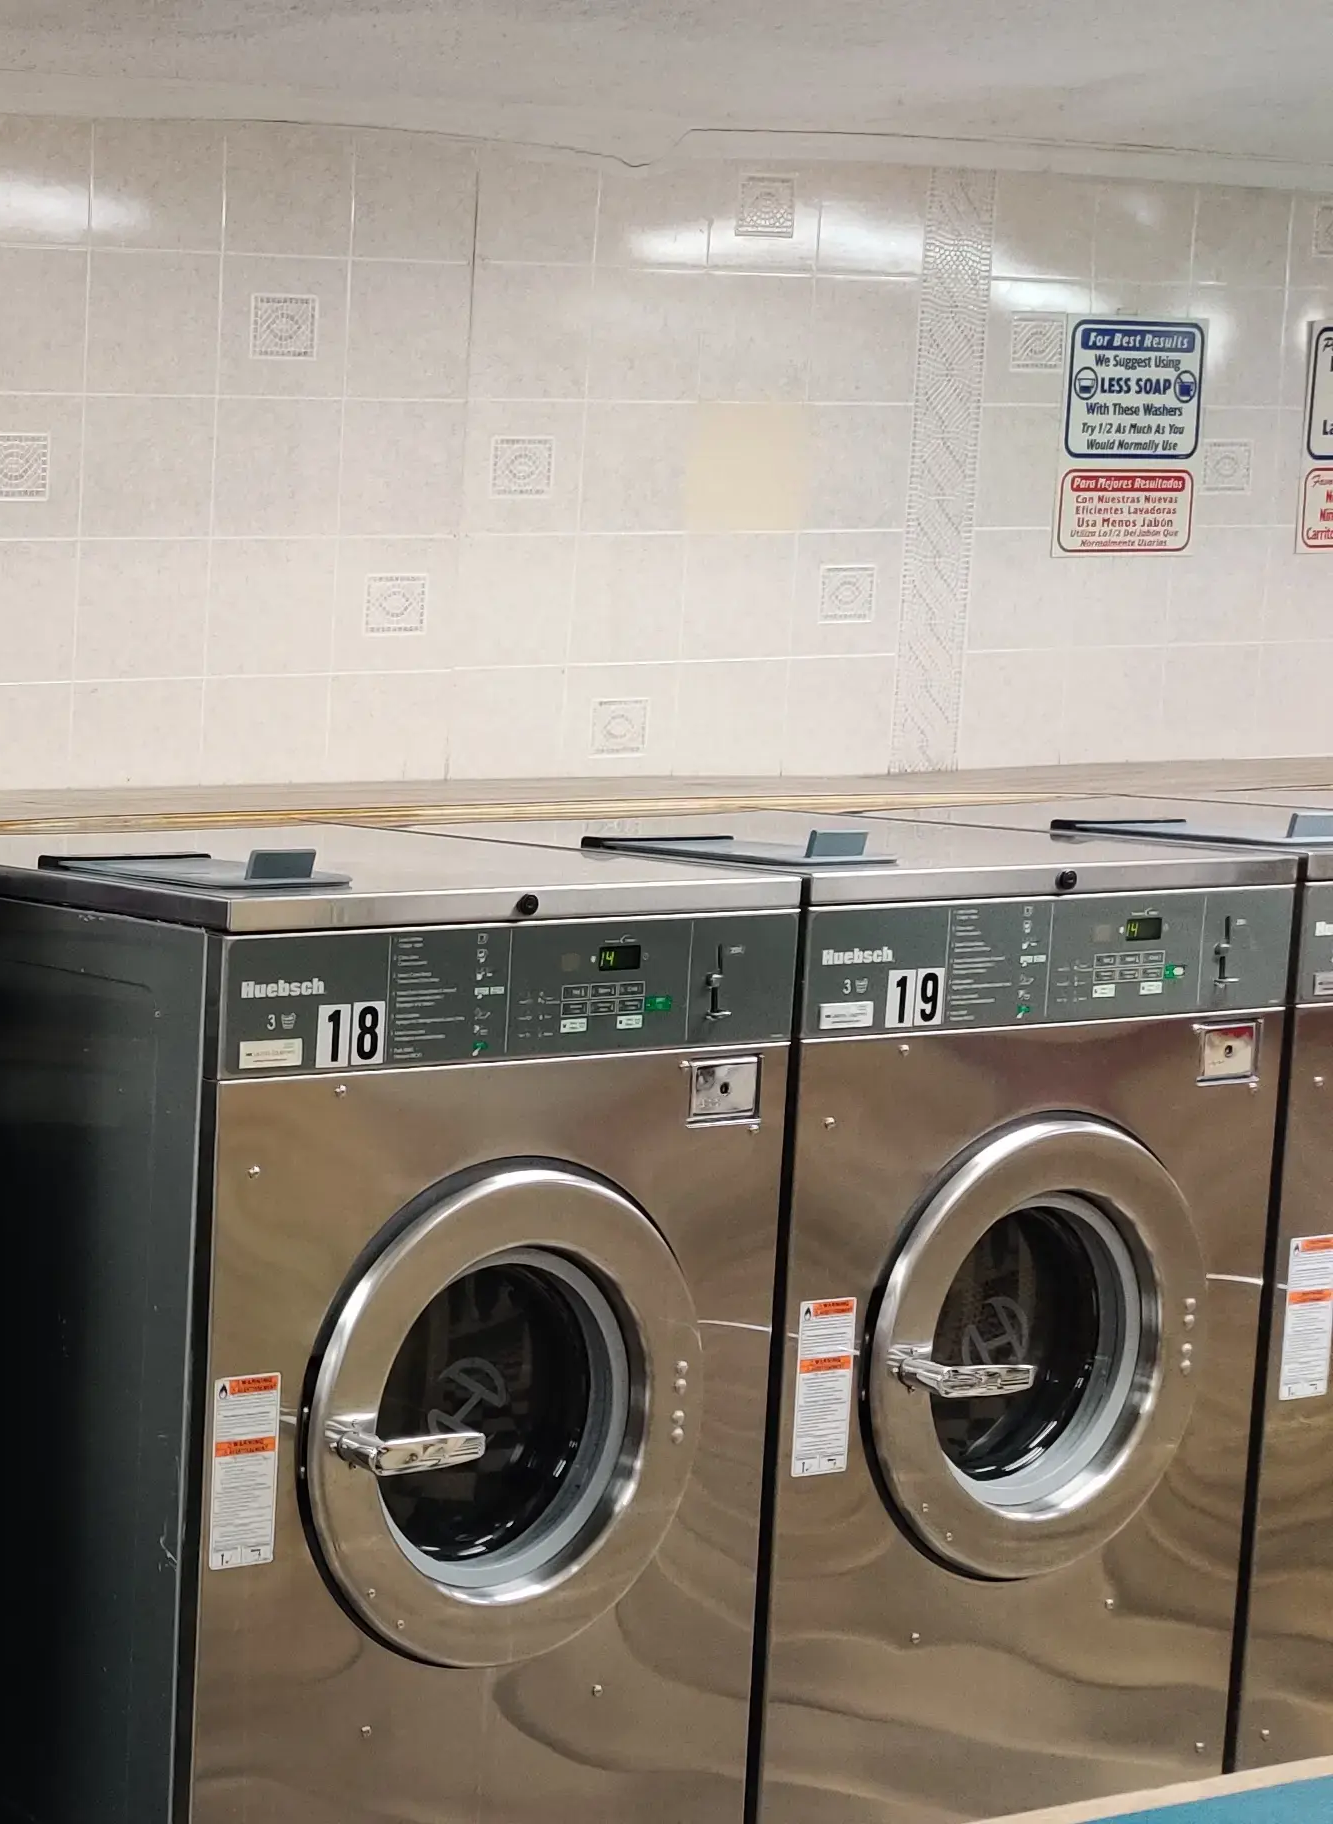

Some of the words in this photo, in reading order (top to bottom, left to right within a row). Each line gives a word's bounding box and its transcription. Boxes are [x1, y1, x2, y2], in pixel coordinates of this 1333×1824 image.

[1088, 332, 1111, 346] For
[1113, 333, 1141, 347] Best
[1144, 334, 1189, 348] Results
[1095, 354, 1111, 367] We
[1113, 355, 1151, 370] Suggest
[1154, 356, 1181, 371] Using
[1100, 377, 1131, 394] LESS
[1135, 378, 1172, 395] SOAP
[1086, 402, 1109, 416] With
[1112, 403, 1140, 416] These
[1143, 403, 1183, 417] Washers
[1081, 422, 1096, 436] Try
[1098, 422, 1112, 435] 1/2
[1115, 423, 1126, 434] As
[1128, 423, 1152, 435] Much
[1154, 424, 1165, 435] As
[1168, 424, 1185, 435] You
[1086, 439, 1115, 450] Would
[1117, 439, 1160, 453] Normally
[1162, 440, 1178, 451] Use
[1073, 478, 1095, 488] Para
[1097, 477, 1132, 490] Mejores
[1134, 478, 1183, 489] Resultados
[1076, 495, 1094, 504] Con
[1097, 495, 1140, 504] Nuestras
[1144, 495, 1178, 504] Nuevas
[1075, 506, 1124, 515] Eficientes
[1128, 506, 1177, 515] Lavadoras
[1077, 517, 1097, 527] Usa
[1101, 517, 1137, 527] Menos
[1141, 517, 1173, 527] Jabón
[822, 946, 894, 966] Huebsch
[241, 978, 326, 998] Huebsch
[842, 979, 852, 994] 3
[896, 973, 939, 1023] 19
[267, 1014, 276, 1031] 3
[328, 1006, 379, 1063] 18
